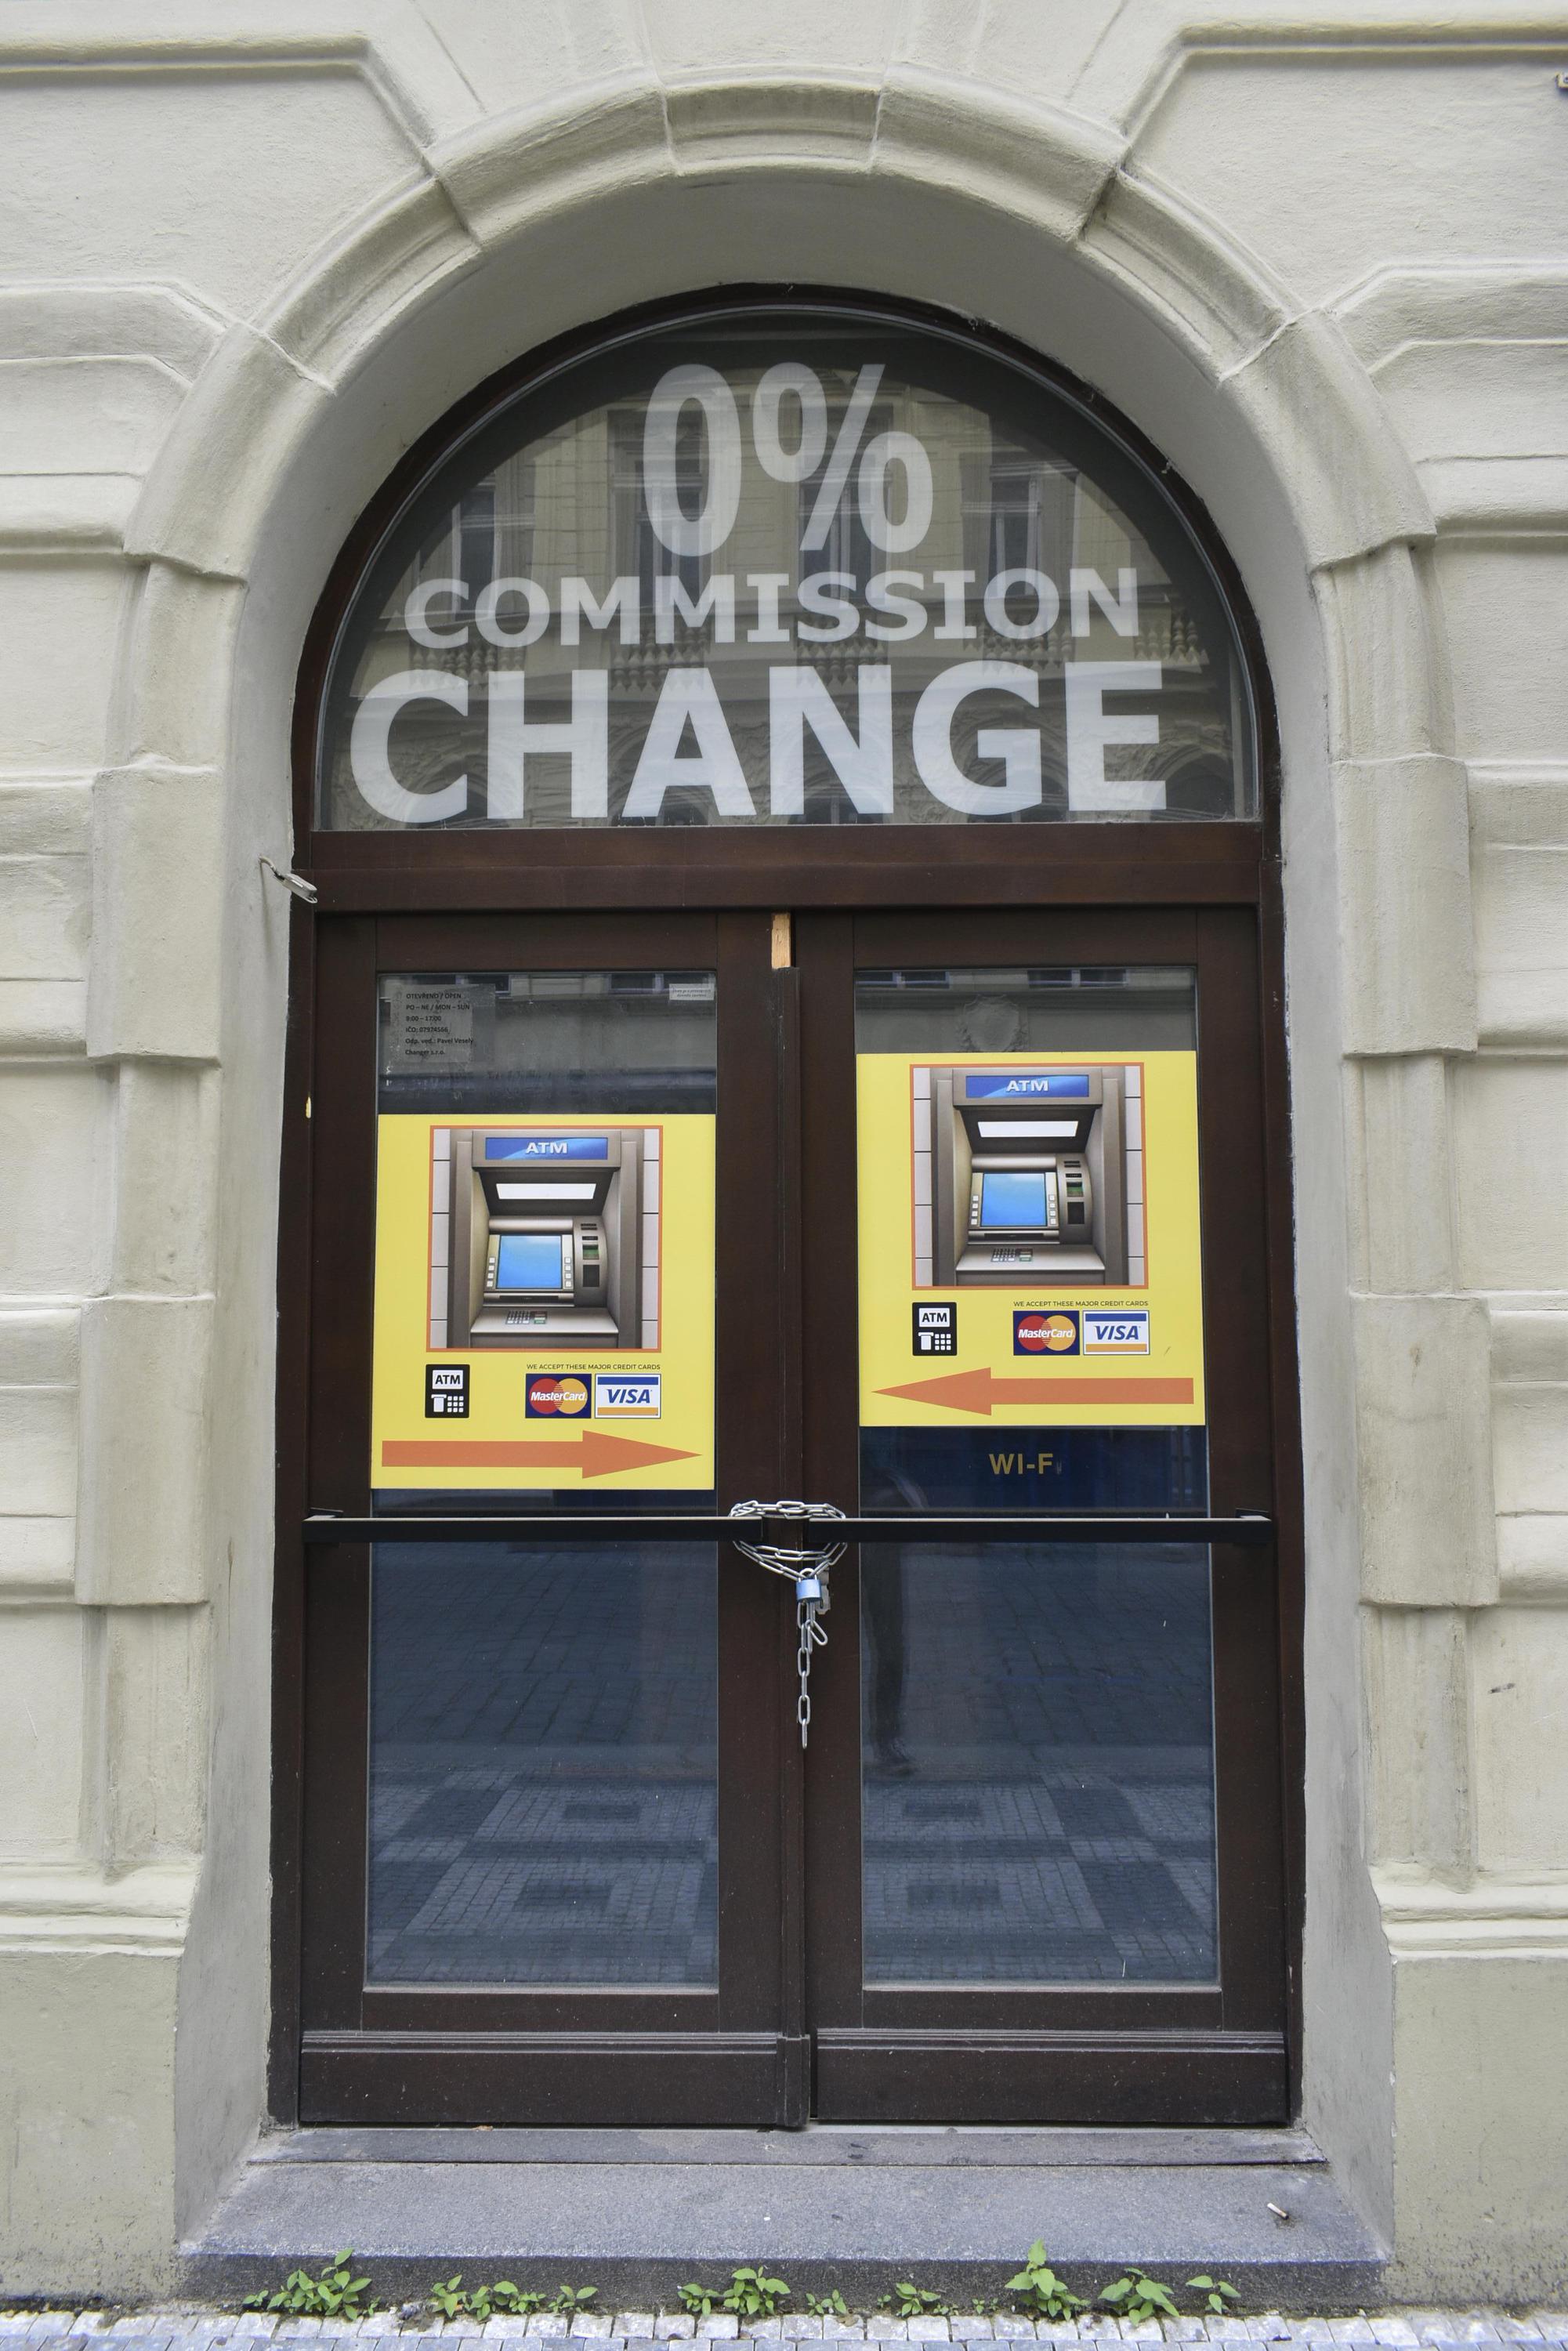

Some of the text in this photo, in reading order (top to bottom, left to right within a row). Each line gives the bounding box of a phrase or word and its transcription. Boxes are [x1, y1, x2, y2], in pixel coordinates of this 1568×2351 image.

[641, 361, 934, 557] 0%
[404, 567, 1139, 650] COMMISSION
[349, 660, 1168, 824] CHANGE
[1005, 1080, 1049, 1092] ATM
[525, 1142, 569, 1154] ATM
[922, 1312, 947, 1323] ATM
[1018, 1328, 1074, 1339] MasterCard
[1095, 1325, 1139, 1340] VISA
[435, 1375, 461, 1385] ATM
[531, 1391, 586, 1401] MasterCard
[607, 1389, 651, 1404] VISA
